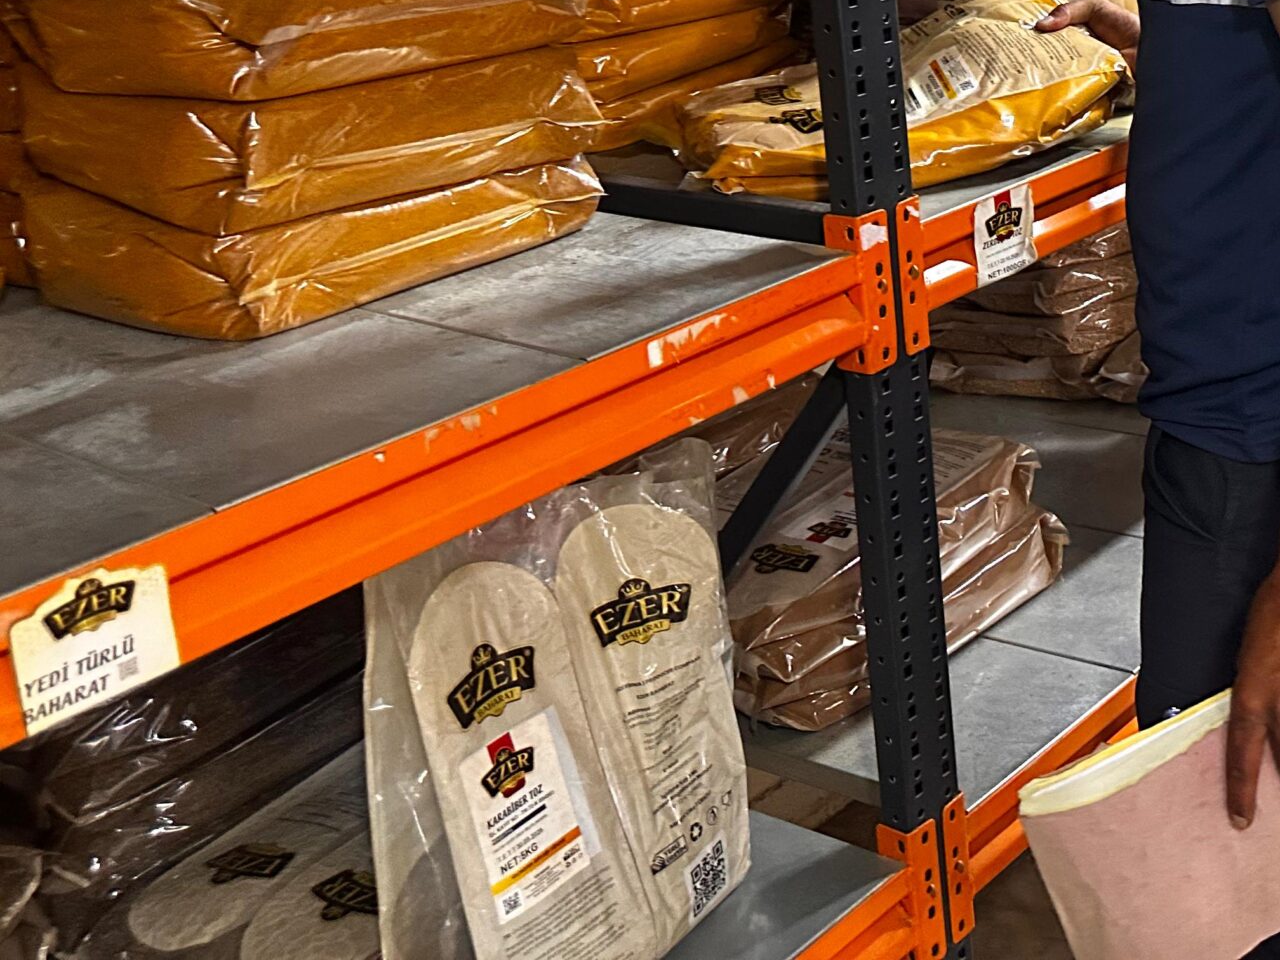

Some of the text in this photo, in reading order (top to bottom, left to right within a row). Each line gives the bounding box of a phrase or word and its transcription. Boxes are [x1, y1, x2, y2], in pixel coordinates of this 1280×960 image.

[988, 209, 1018, 231] EZER
[52, 586, 127, 630] EZER
[595, 591, 682, 634] EZER
[24, 634, 135, 698] YEDİ TÜRLÜ
[454, 655, 531, 714] EZER
[486, 751, 529, 788] EZER
[529, 784, 544, 800] TOZ
